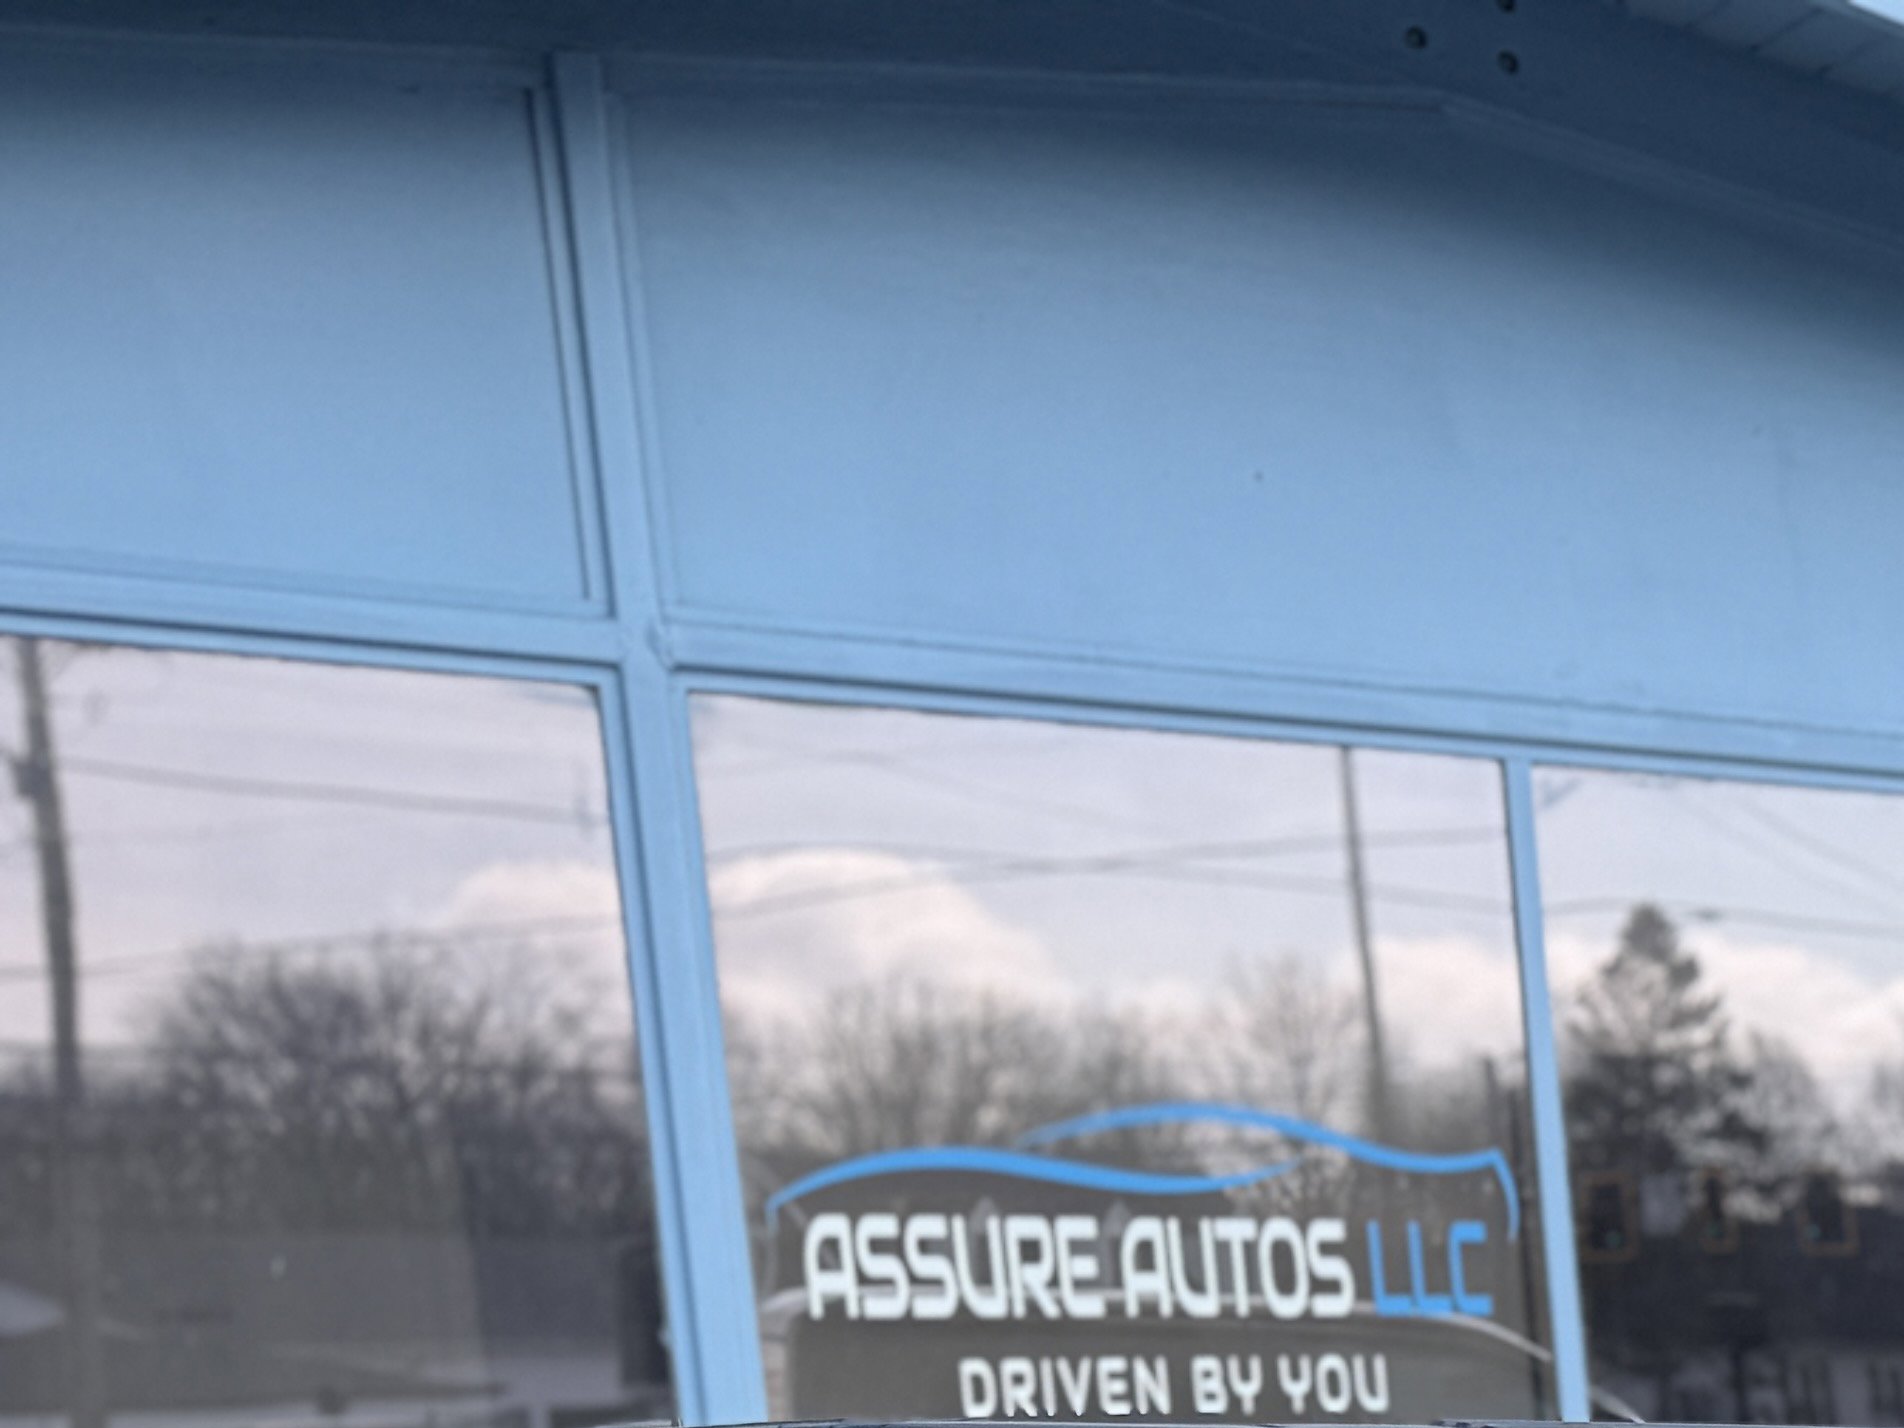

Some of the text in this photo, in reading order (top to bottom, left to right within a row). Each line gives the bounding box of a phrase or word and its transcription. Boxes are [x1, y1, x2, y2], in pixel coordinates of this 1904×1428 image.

[804, 1212, 1494, 1321] ASSURE AUTOS LLC
[958, 1353, 1390, 1420] DRIVEN BY YOU
